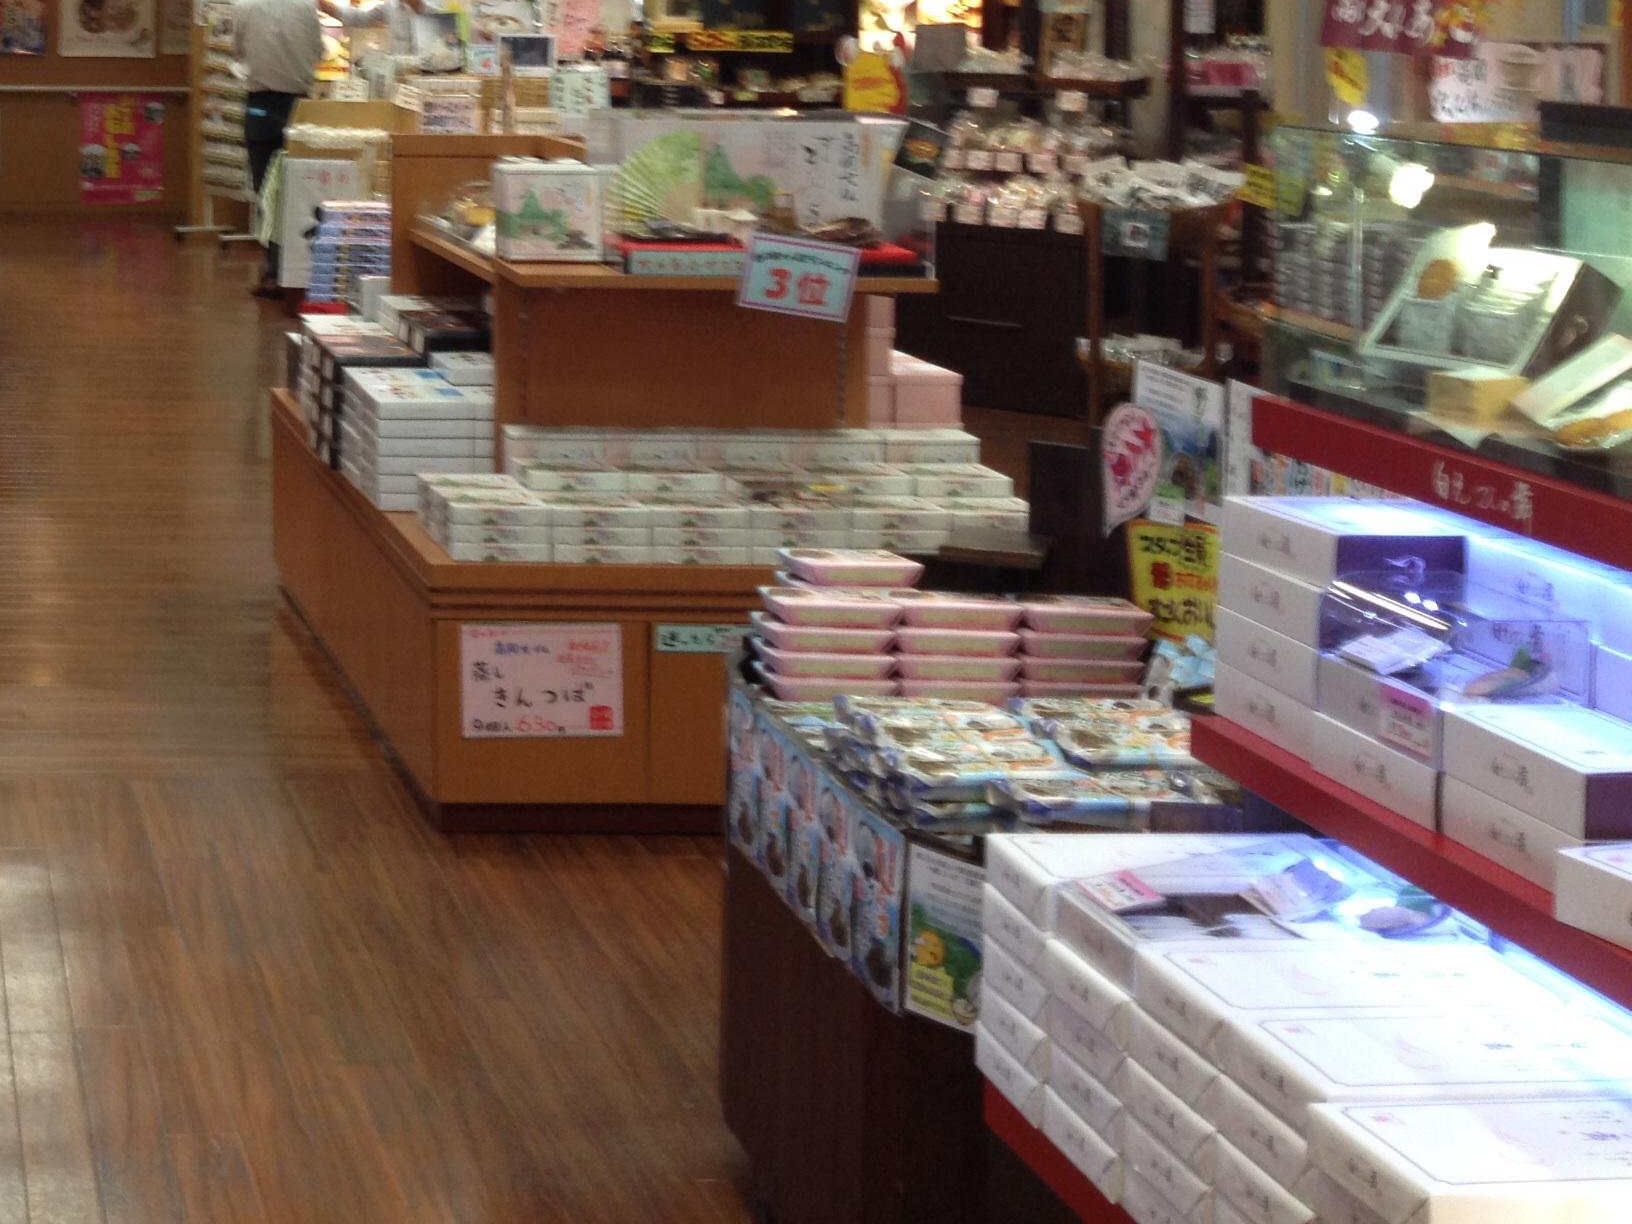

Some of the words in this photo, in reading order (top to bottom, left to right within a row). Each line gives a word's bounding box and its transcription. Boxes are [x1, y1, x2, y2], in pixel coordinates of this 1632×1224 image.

[762, 267, 832, 306] 3位
[492, 681, 595, 708] きんつば
